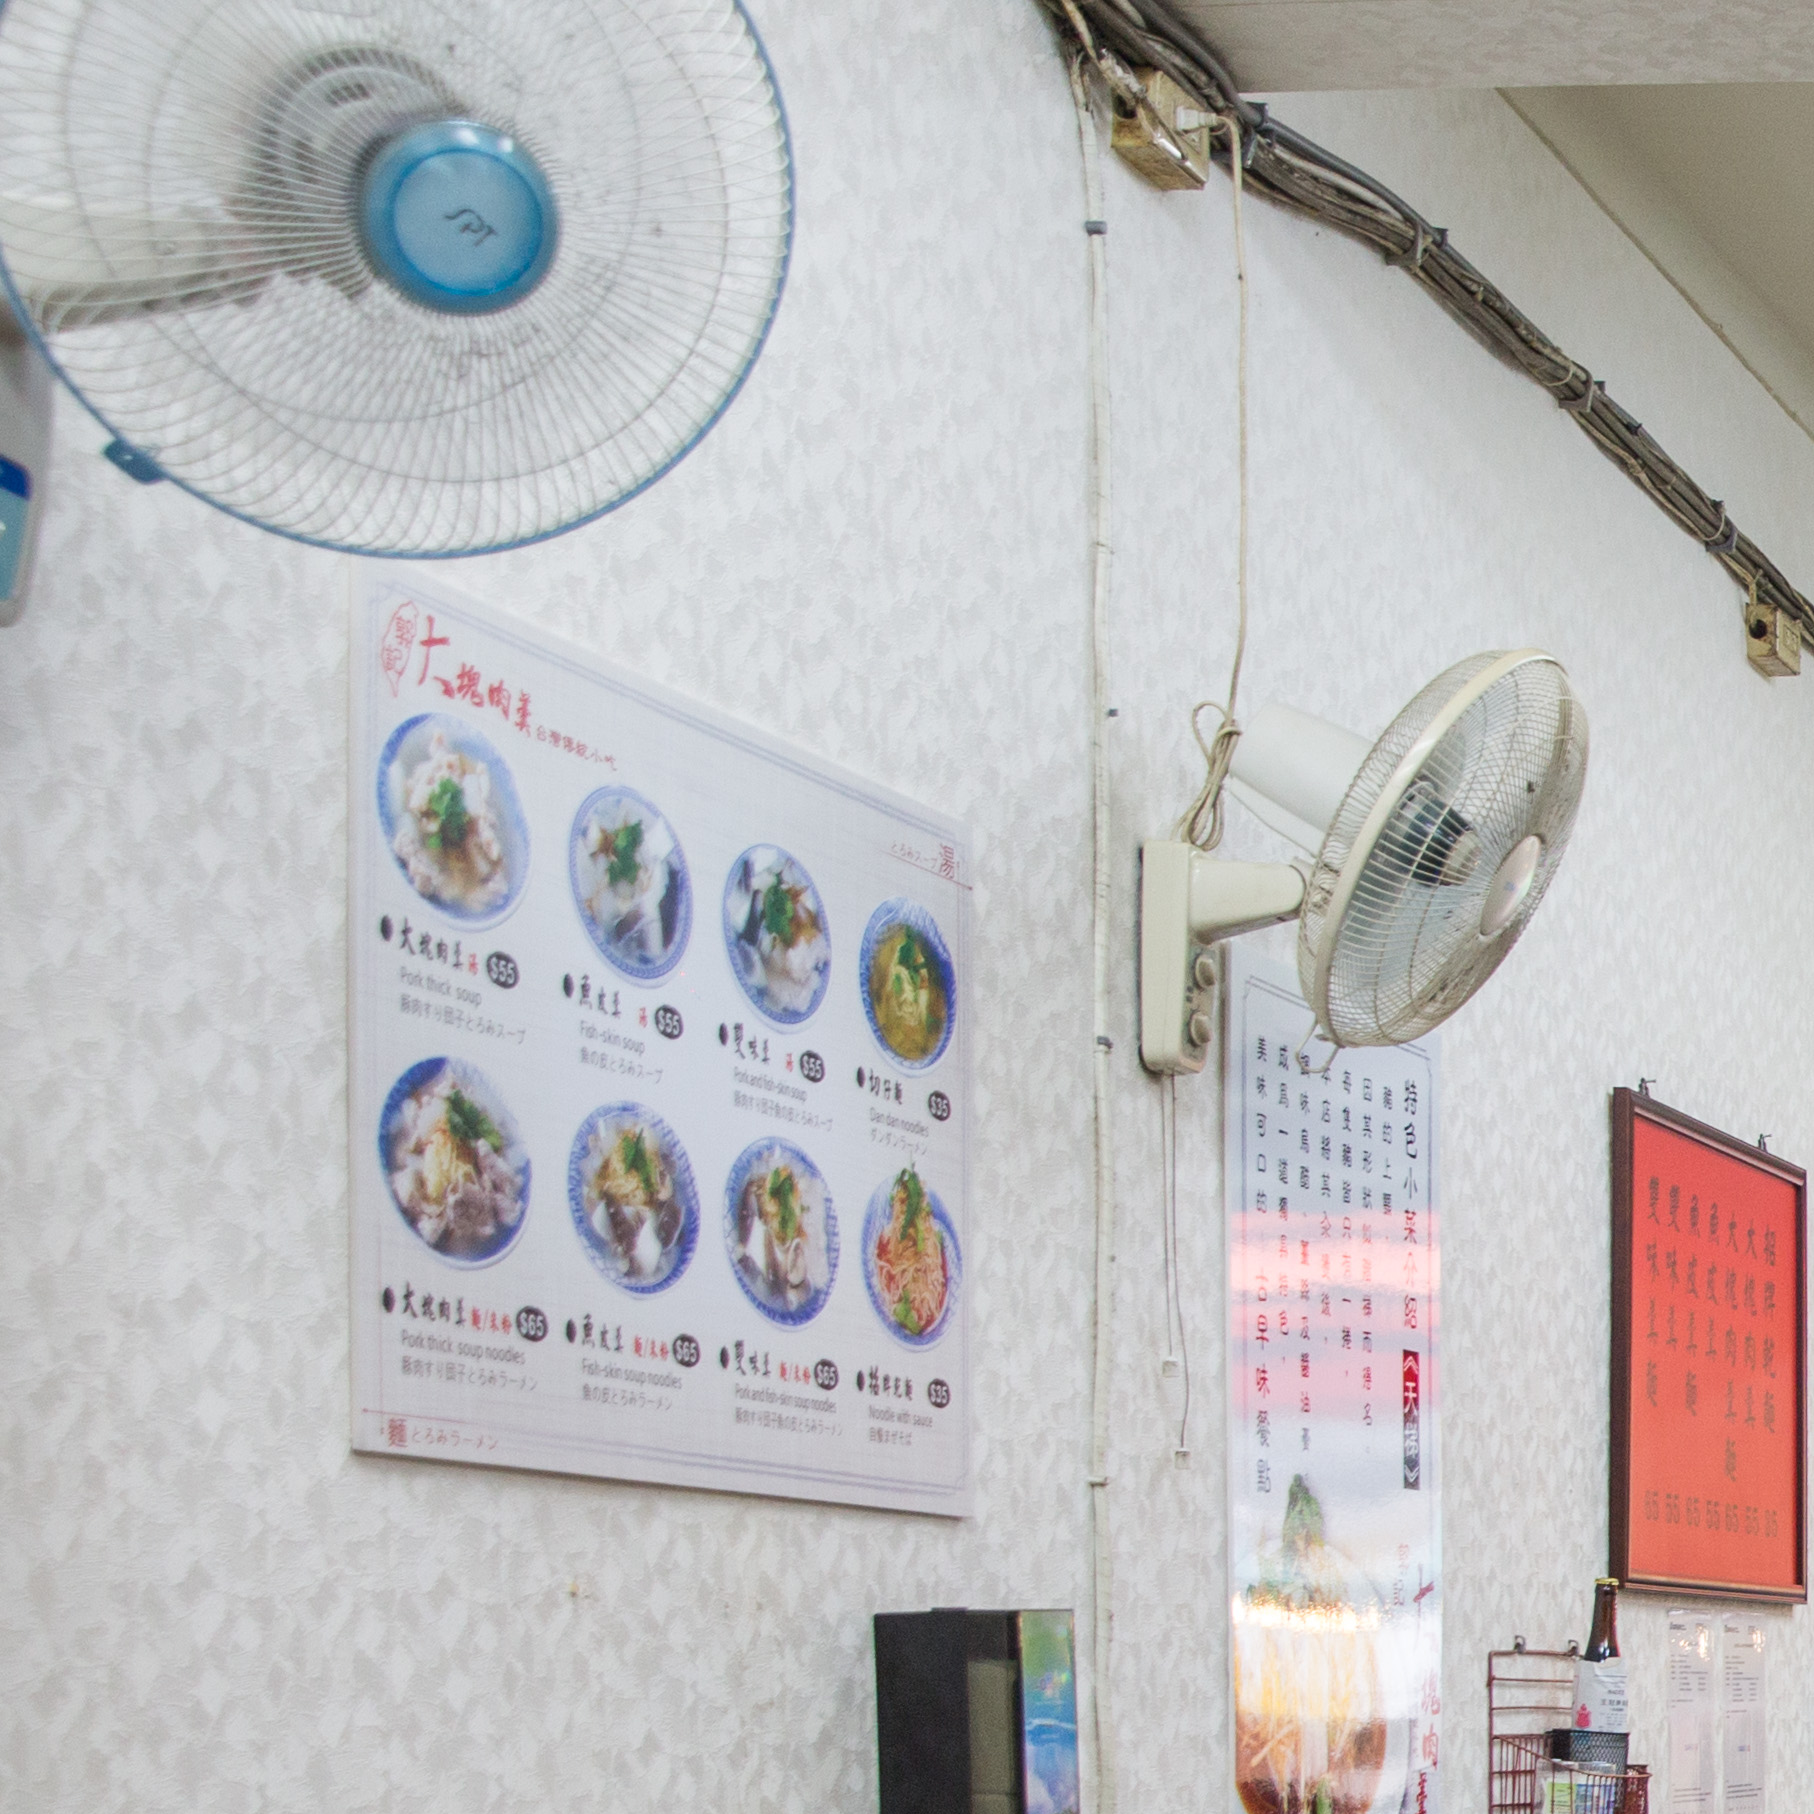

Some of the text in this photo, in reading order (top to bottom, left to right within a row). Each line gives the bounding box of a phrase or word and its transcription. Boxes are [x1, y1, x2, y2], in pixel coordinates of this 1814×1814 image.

[487, 953, 518, 987] $55
[400, 966, 482, 1008] Pork thick soup
[656, 1007, 682, 1037] $55
[580, 1020, 645, 1055] Fish-skin soup
[801, 1054, 825, 1081] $55
[929, 1093, 950, 1119] $35
[899, 1117, 929, 1137] noodles
[1402, 1079, 1420, 1330] 特色小菜介紹
[518, 1309, 546, 1339] $65
[402, 1328, 525, 1365] Pork thick soup noodles
[673, 1337, 700, 1366] $65
[582, 1357, 683, 1390] Fish-skin soup noodles
[815, 1363, 839, 1389] $65
[928, 1381, 950, 1408] $35
[869, 1404, 933, 1428] Noodle with sauce
